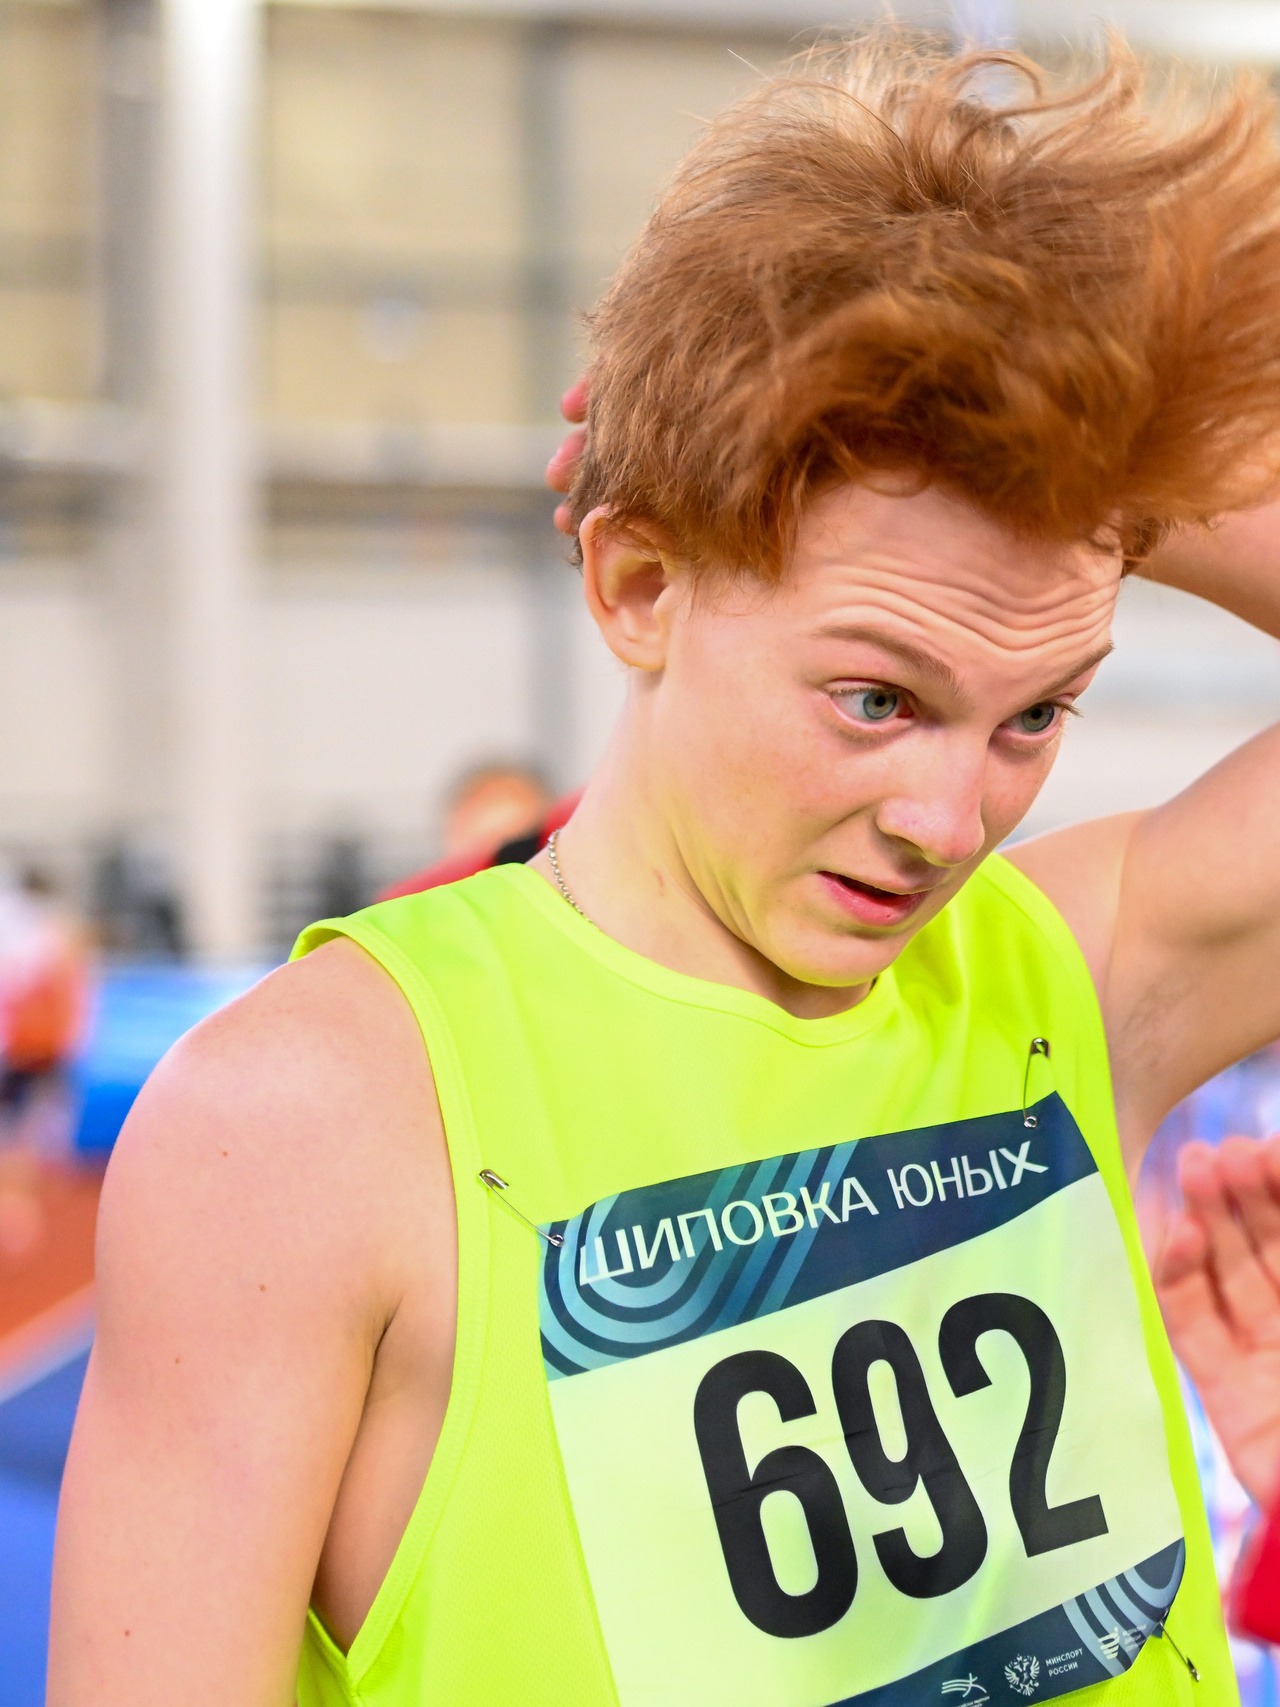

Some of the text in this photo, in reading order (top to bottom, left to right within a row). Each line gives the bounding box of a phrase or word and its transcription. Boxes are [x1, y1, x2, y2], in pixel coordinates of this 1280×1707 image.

[579, 1140, 1049, 1286] ШИПОВКА ЮНЫХ
[693, 1291, 1109, 1638] 692
[1045, 1648, 1083, 1667] МИНСПОРТ
[1048, 1661, 1079, 1677] РОССИИ
